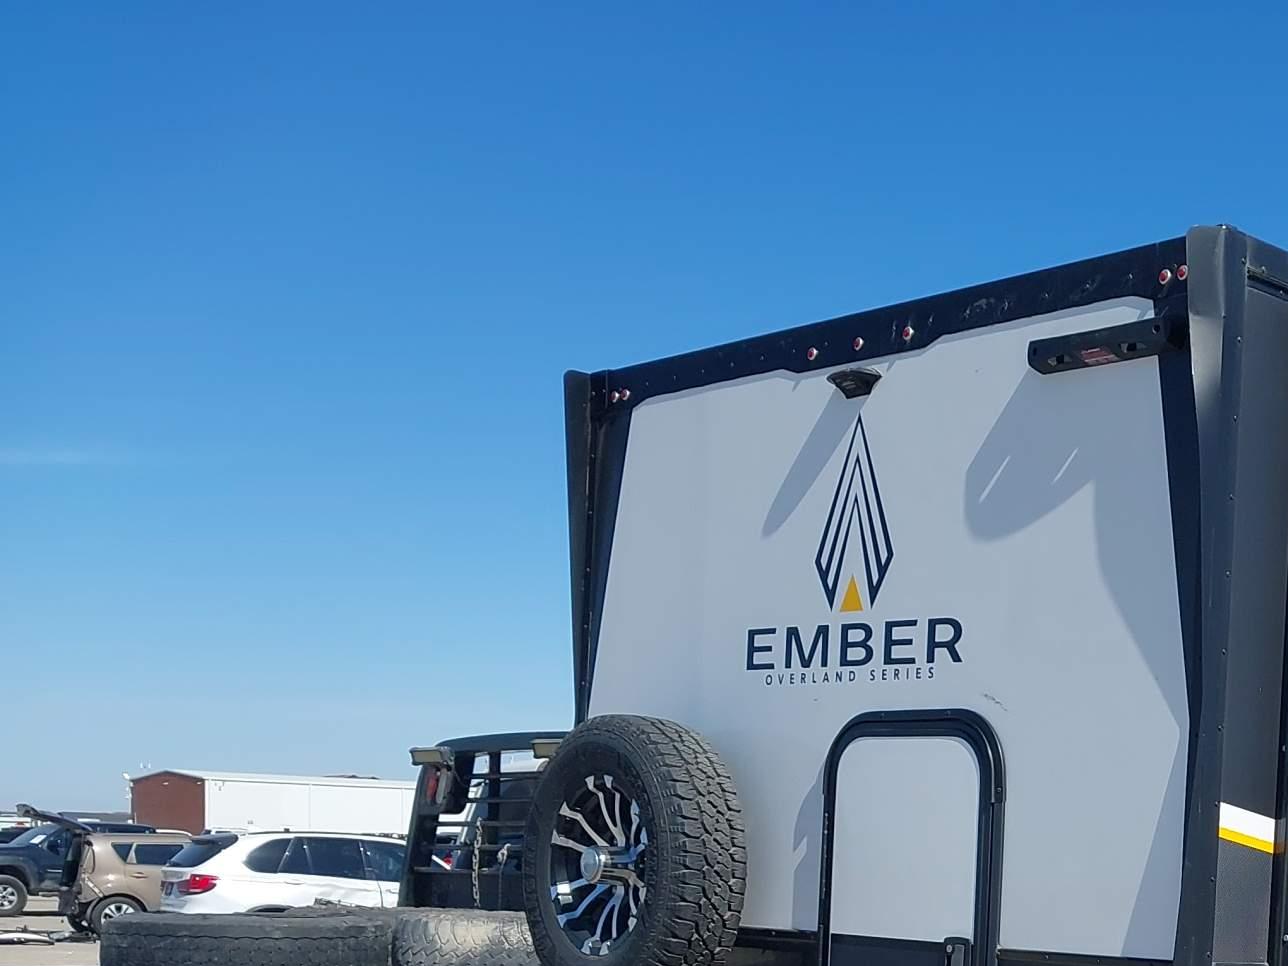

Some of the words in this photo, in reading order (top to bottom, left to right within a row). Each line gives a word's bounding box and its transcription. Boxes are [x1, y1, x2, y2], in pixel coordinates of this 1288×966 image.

[746, 617, 964, 671] EMBER
[765, 670, 856, 686] OVERLAND
[869, 667, 936, 682] SERIES
